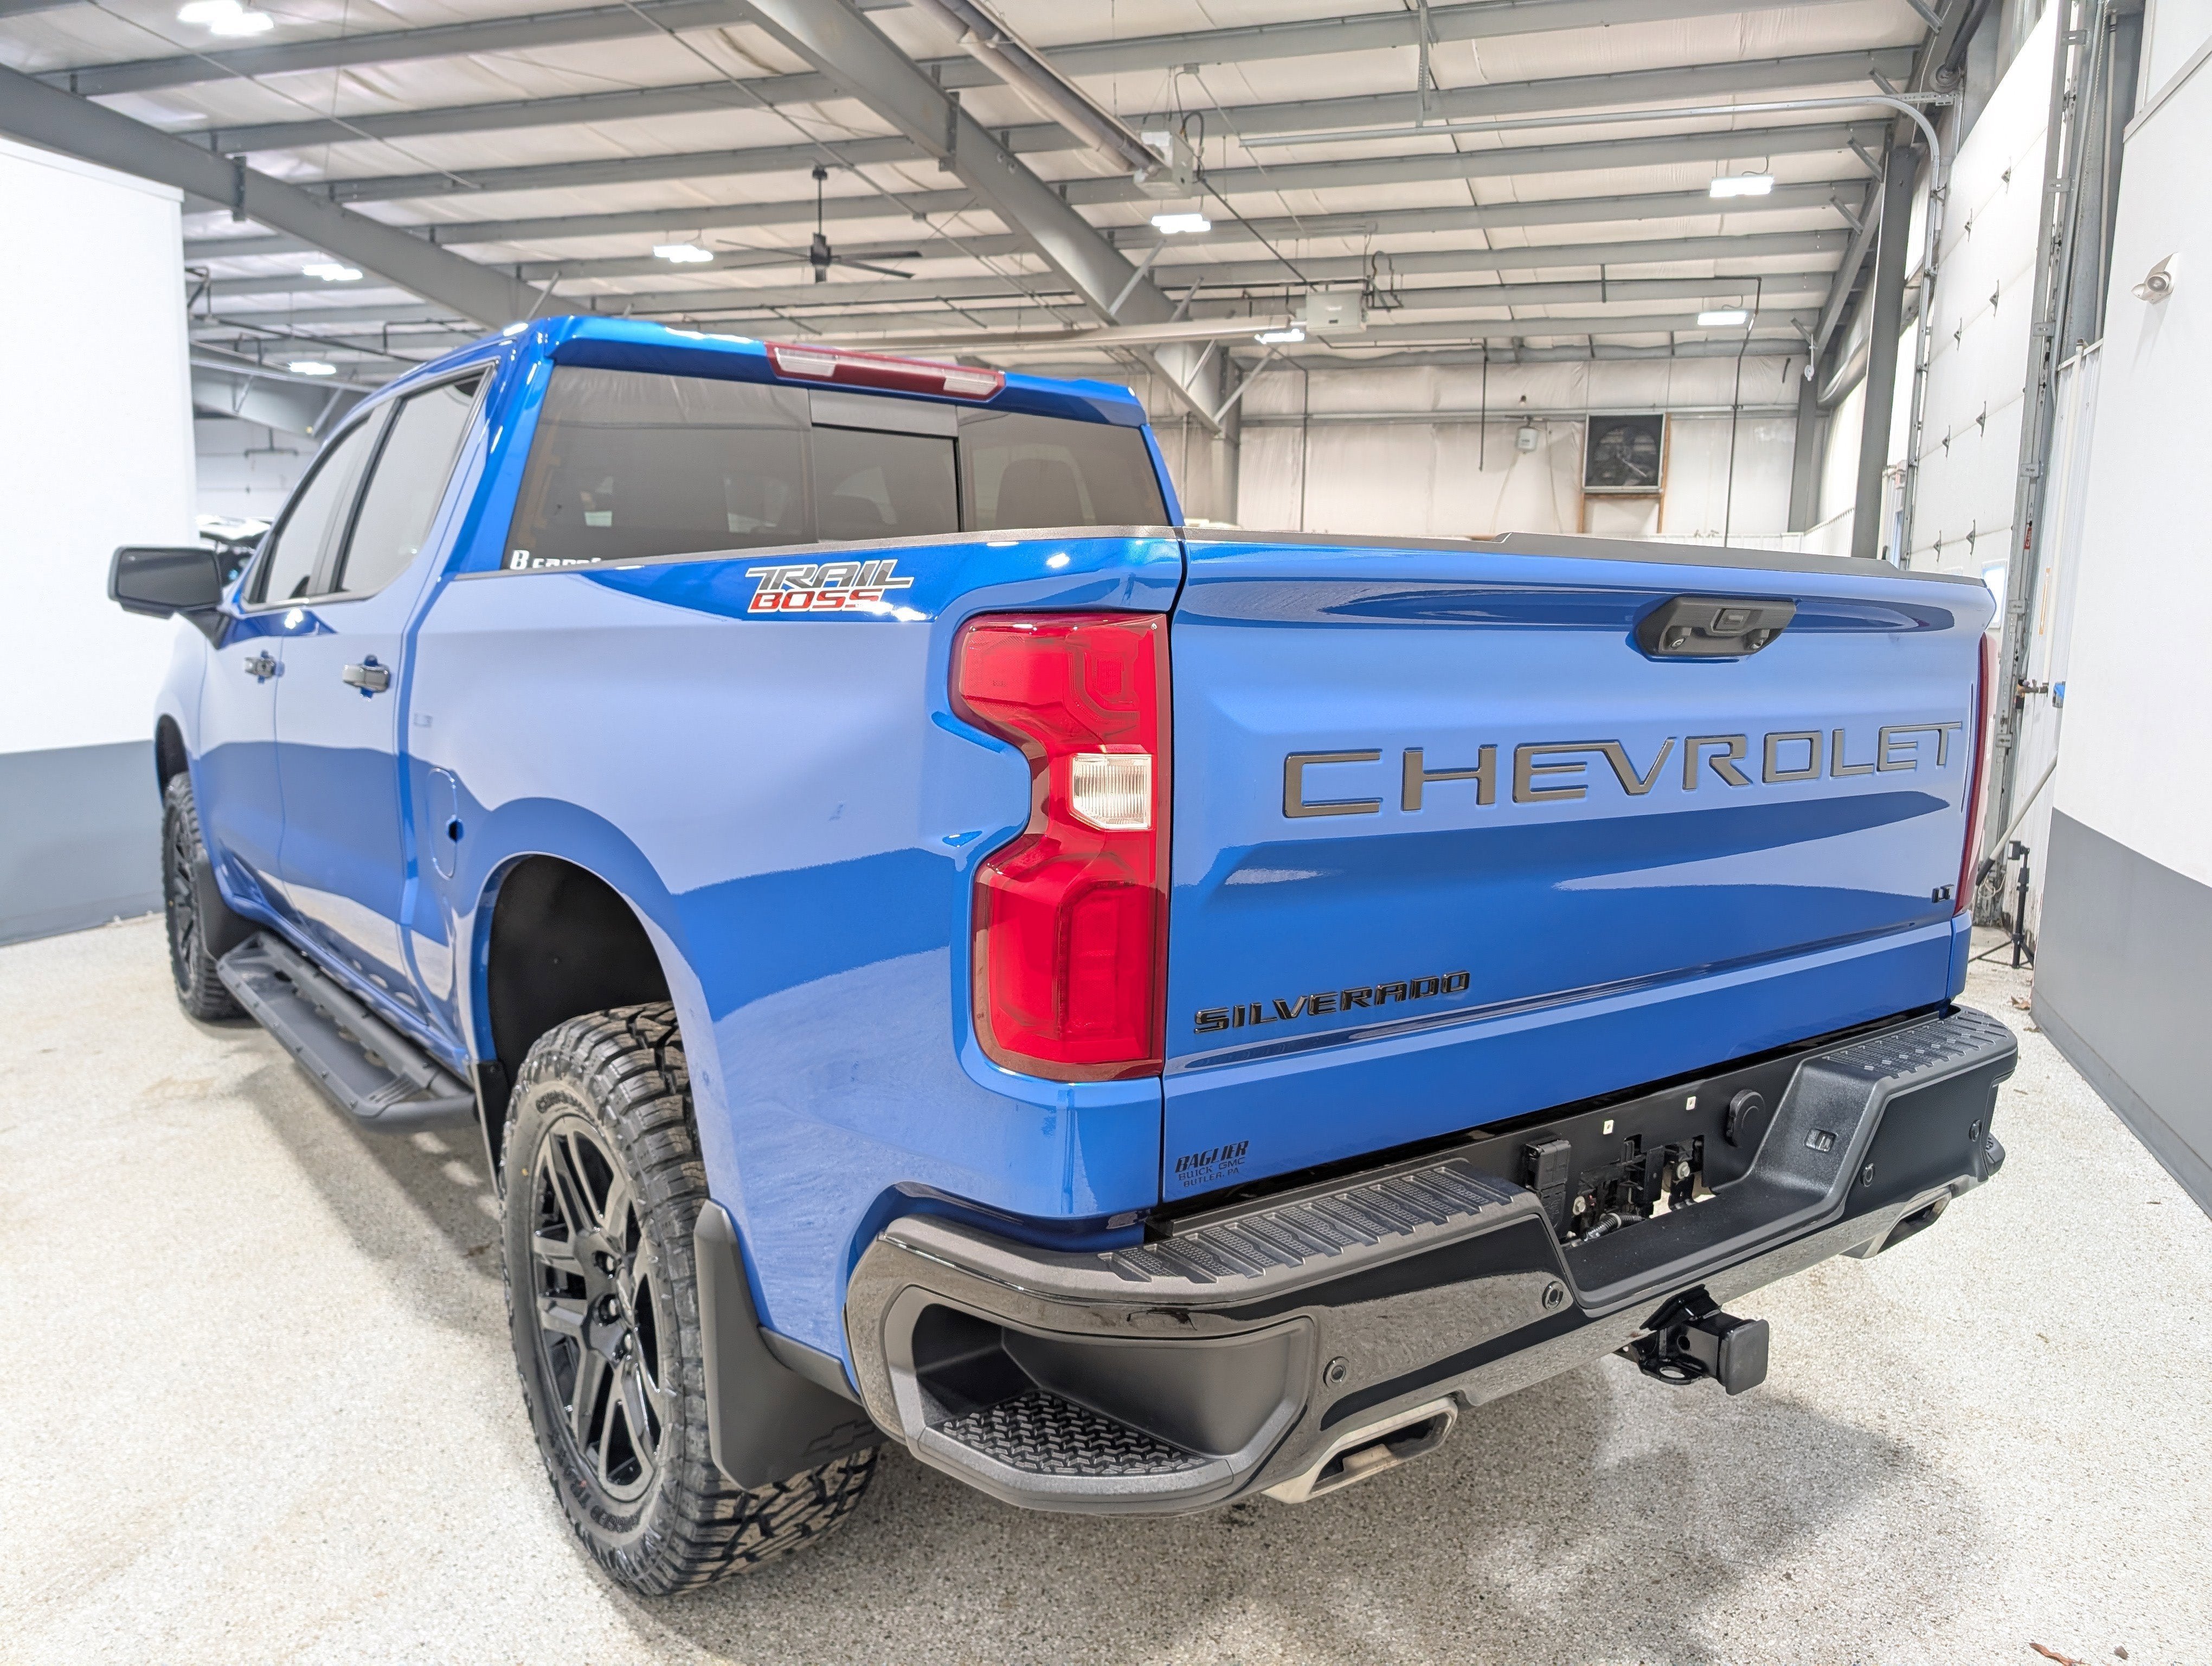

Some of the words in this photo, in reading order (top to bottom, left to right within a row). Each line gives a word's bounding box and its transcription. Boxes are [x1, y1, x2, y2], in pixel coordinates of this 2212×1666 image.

[746, 560, 914, 591] TRAIL
[748, 588, 884, 612] BOSS
[1283, 722, 1963, 818] CHEVROLET
[1931, 884, 1954, 903] LT
[1194, 970, 1470, 1034] SILVERADO
[1175, 1140, 1249, 1172] BAGLIER
[1179, 1165, 1213, 1181] BUICK
[1219, 1157, 1245, 1170] GMC
[1227, 1167, 1239, 1175] PA
